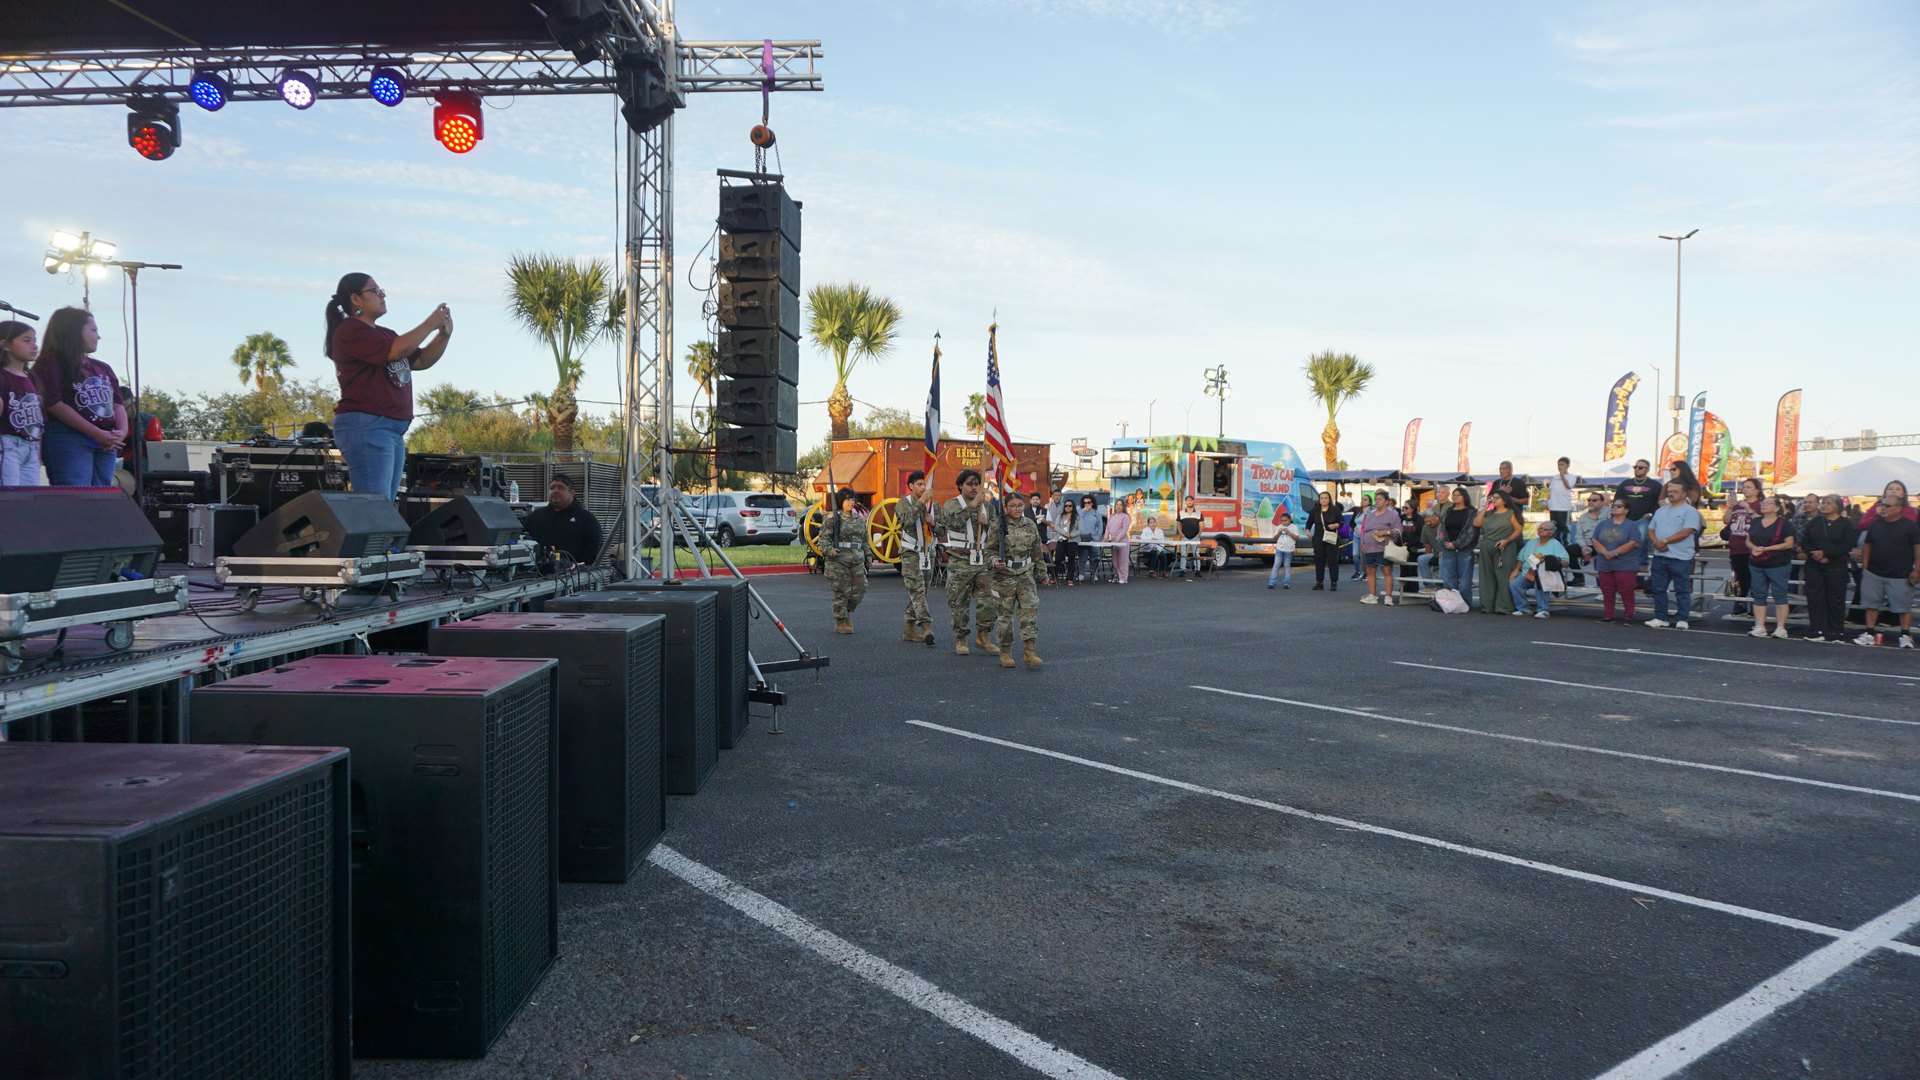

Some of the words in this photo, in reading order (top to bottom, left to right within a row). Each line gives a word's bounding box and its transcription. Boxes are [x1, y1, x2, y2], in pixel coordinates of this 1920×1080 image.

[1613, 378, 1634, 445] KETTLE
[280, 471, 300, 481] RS
[1260, 482, 1290, 493] ISLAND
